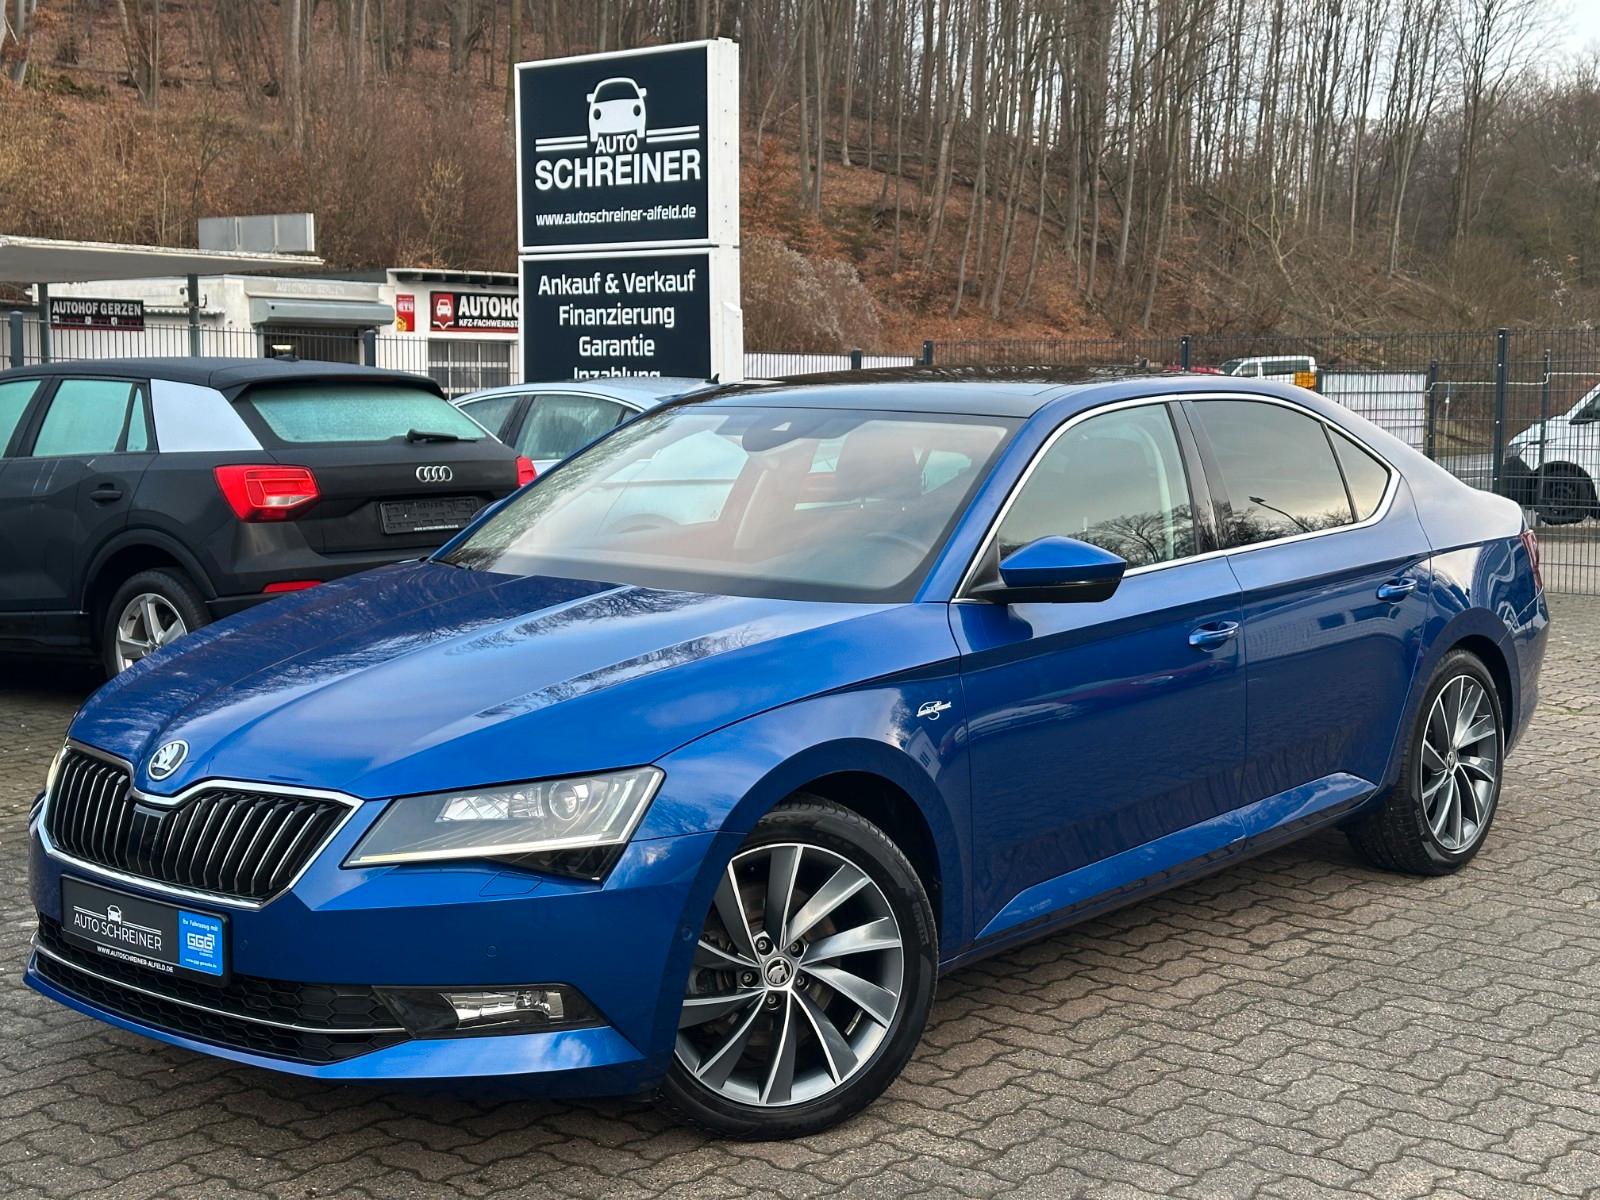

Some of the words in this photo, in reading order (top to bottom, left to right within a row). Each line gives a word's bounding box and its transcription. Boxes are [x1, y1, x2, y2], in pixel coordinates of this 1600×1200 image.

[595, 134, 638, 154] AUTO
[534, 149, 701, 191] SCHREINER
[535, 204, 697, 226] www.autoschreiner-alfeld.de
[538, 272, 601, 295] Ankauf
[605, 273, 620, 294] &
[622, 268, 696, 293] Verkauf
[52, 300, 98, 314] AUTOHOF
[100, 302, 141, 316] GERZEN
[559, 302, 675, 329] Finanzierung
[579, 333, 655, 356] Garantie
[73, 913, 100, 932] AUTO
[101, 921, 162, 951] SCHREINER
[187, 932, 215, 950] GGG
